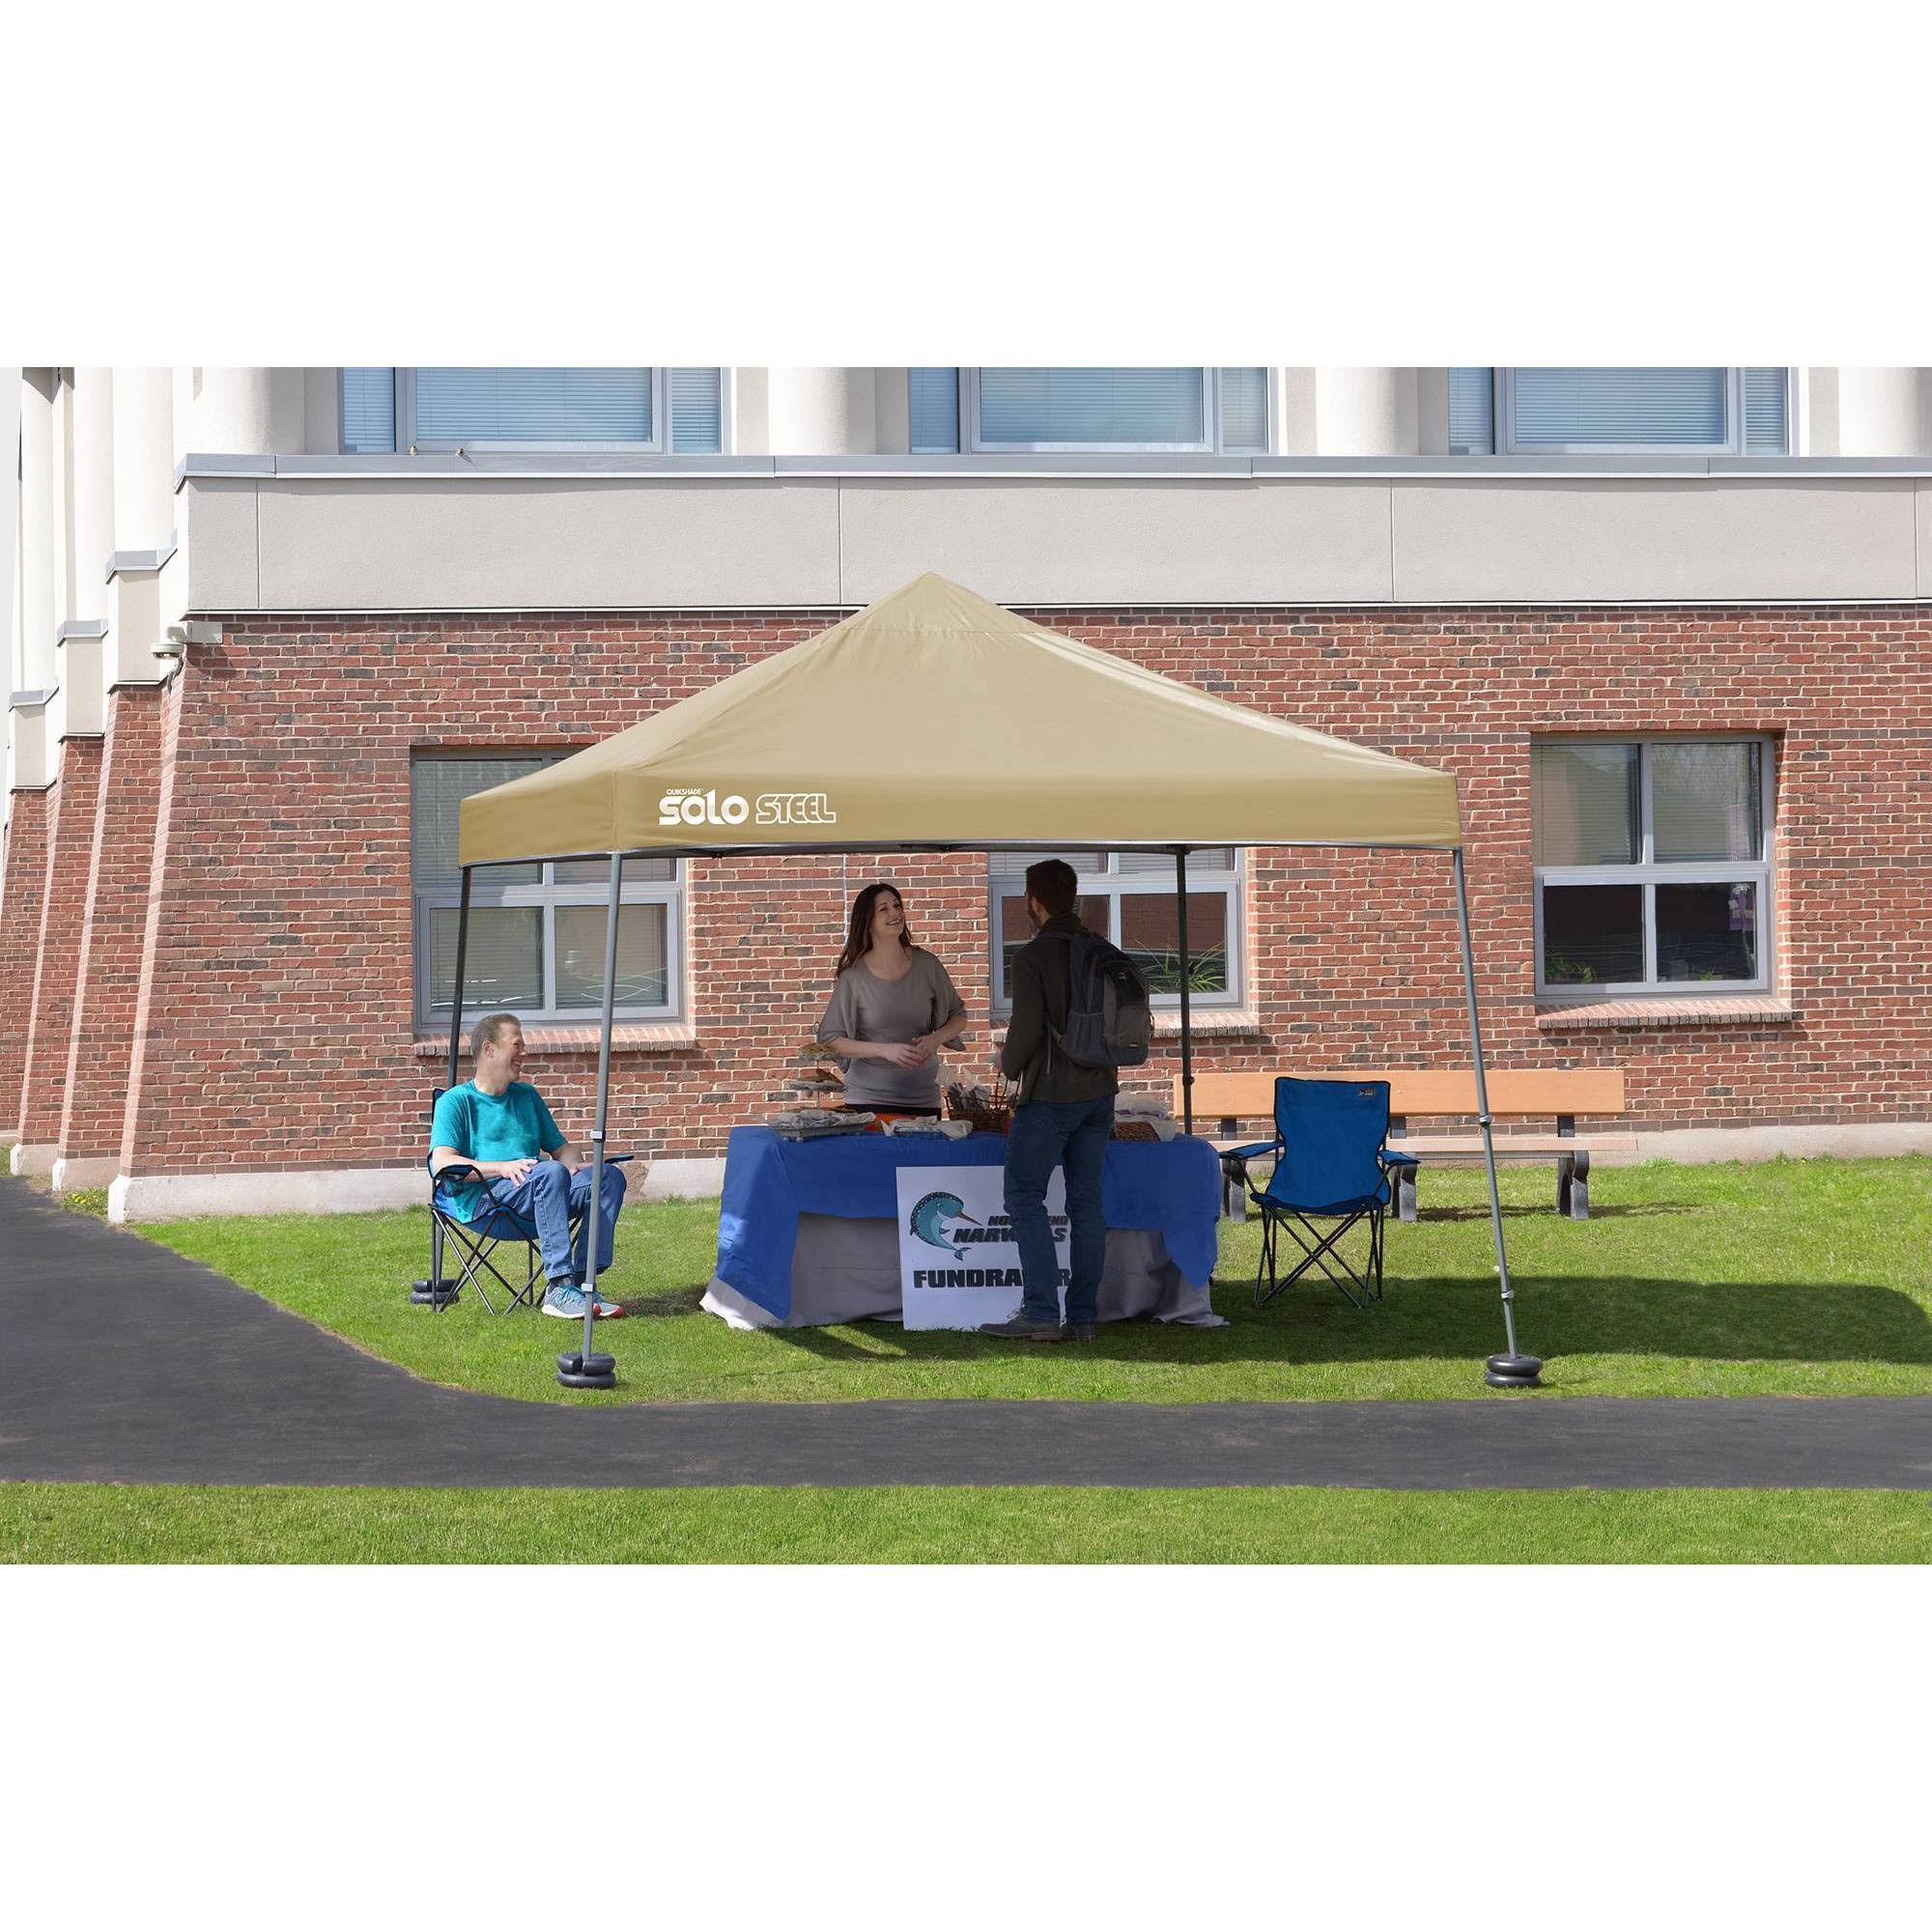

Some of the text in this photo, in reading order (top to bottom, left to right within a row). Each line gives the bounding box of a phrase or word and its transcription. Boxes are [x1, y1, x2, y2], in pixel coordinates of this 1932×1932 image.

[755, 793, 837, 824] STEEL
[952, 1228, 1067, 1242] NARWS
[913, 1268, 1071, 1288] FUNDRAR
